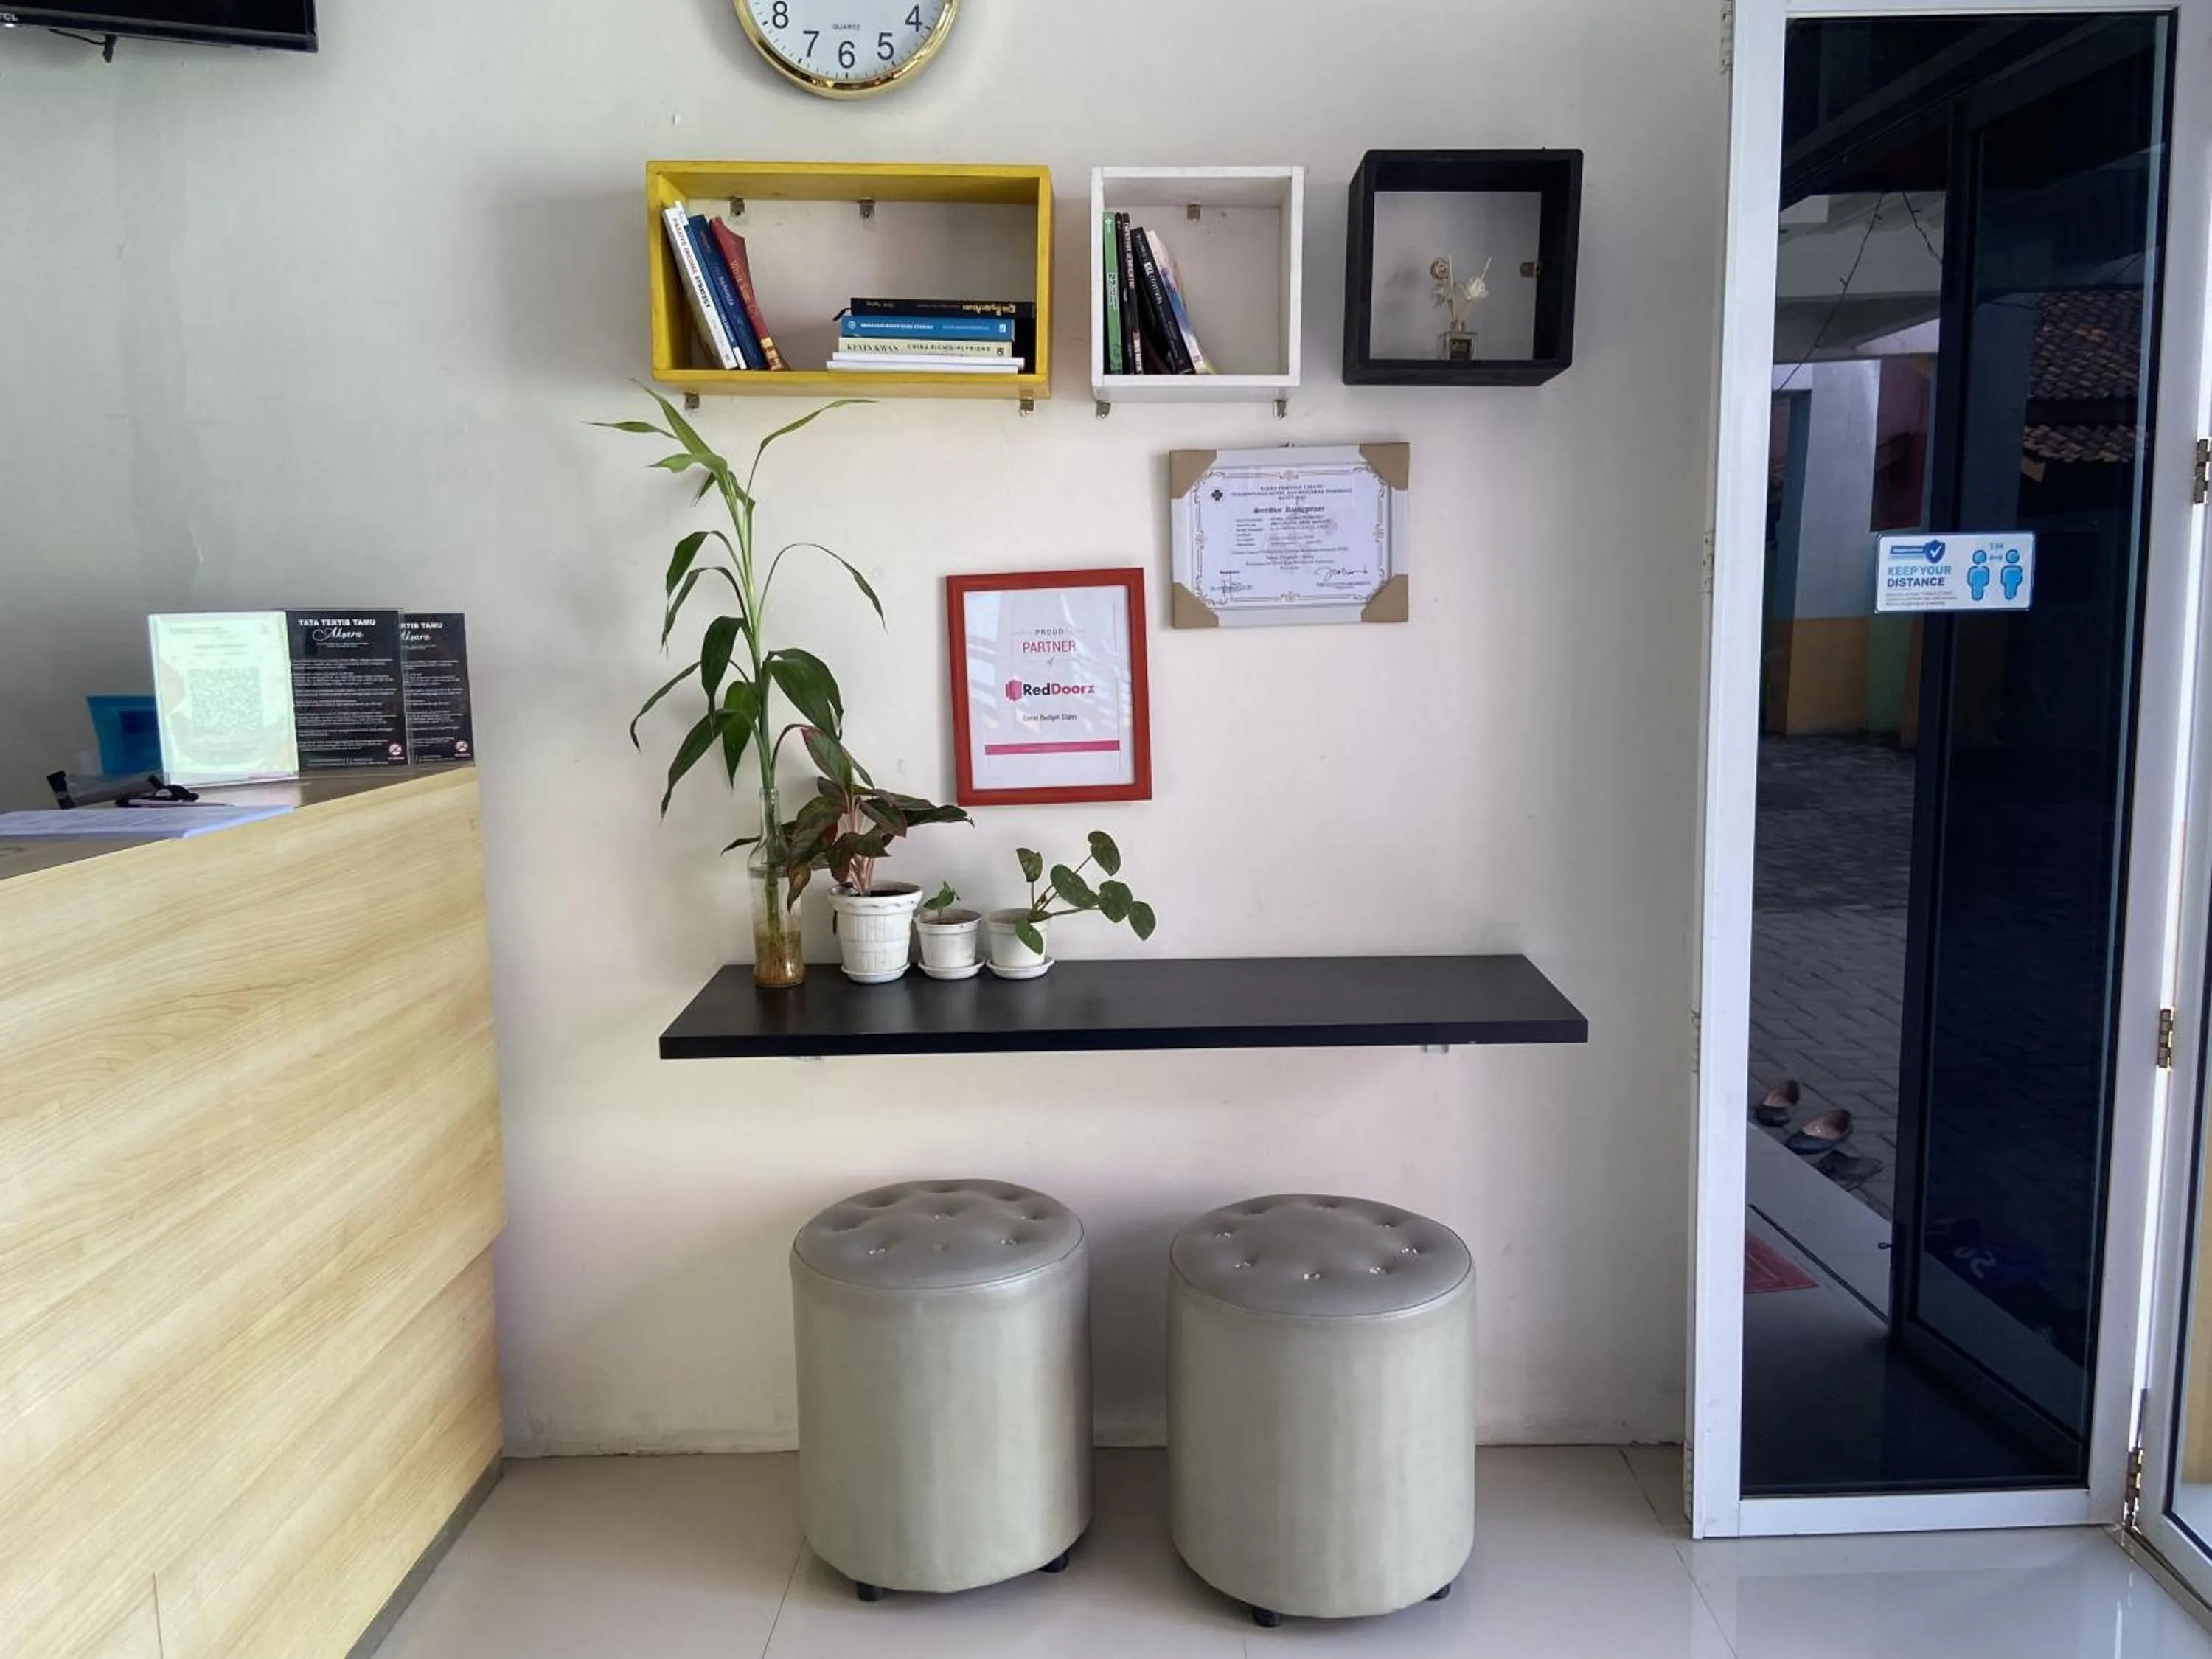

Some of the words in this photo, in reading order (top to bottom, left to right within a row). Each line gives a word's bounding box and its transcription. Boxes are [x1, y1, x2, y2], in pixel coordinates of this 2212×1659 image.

[772, 1, 789, 29] 8
[905, 5, 922, 32] 4
[803, 30, 820, 58] 7
[838, 41, 855, 69] 6
[877, 32, 894, 60] 5
[694, 274, 712, 308] STRATEGY
[1887, 566, 1918, 576] KEEP
[1920, 566, 1952, 576] YOUR
[1887, 577, 1946, 588] DISTANCE
[1023, 639, 1077, 654] PARTNER
[1023, 682, 1096, 696] RedDoorz
